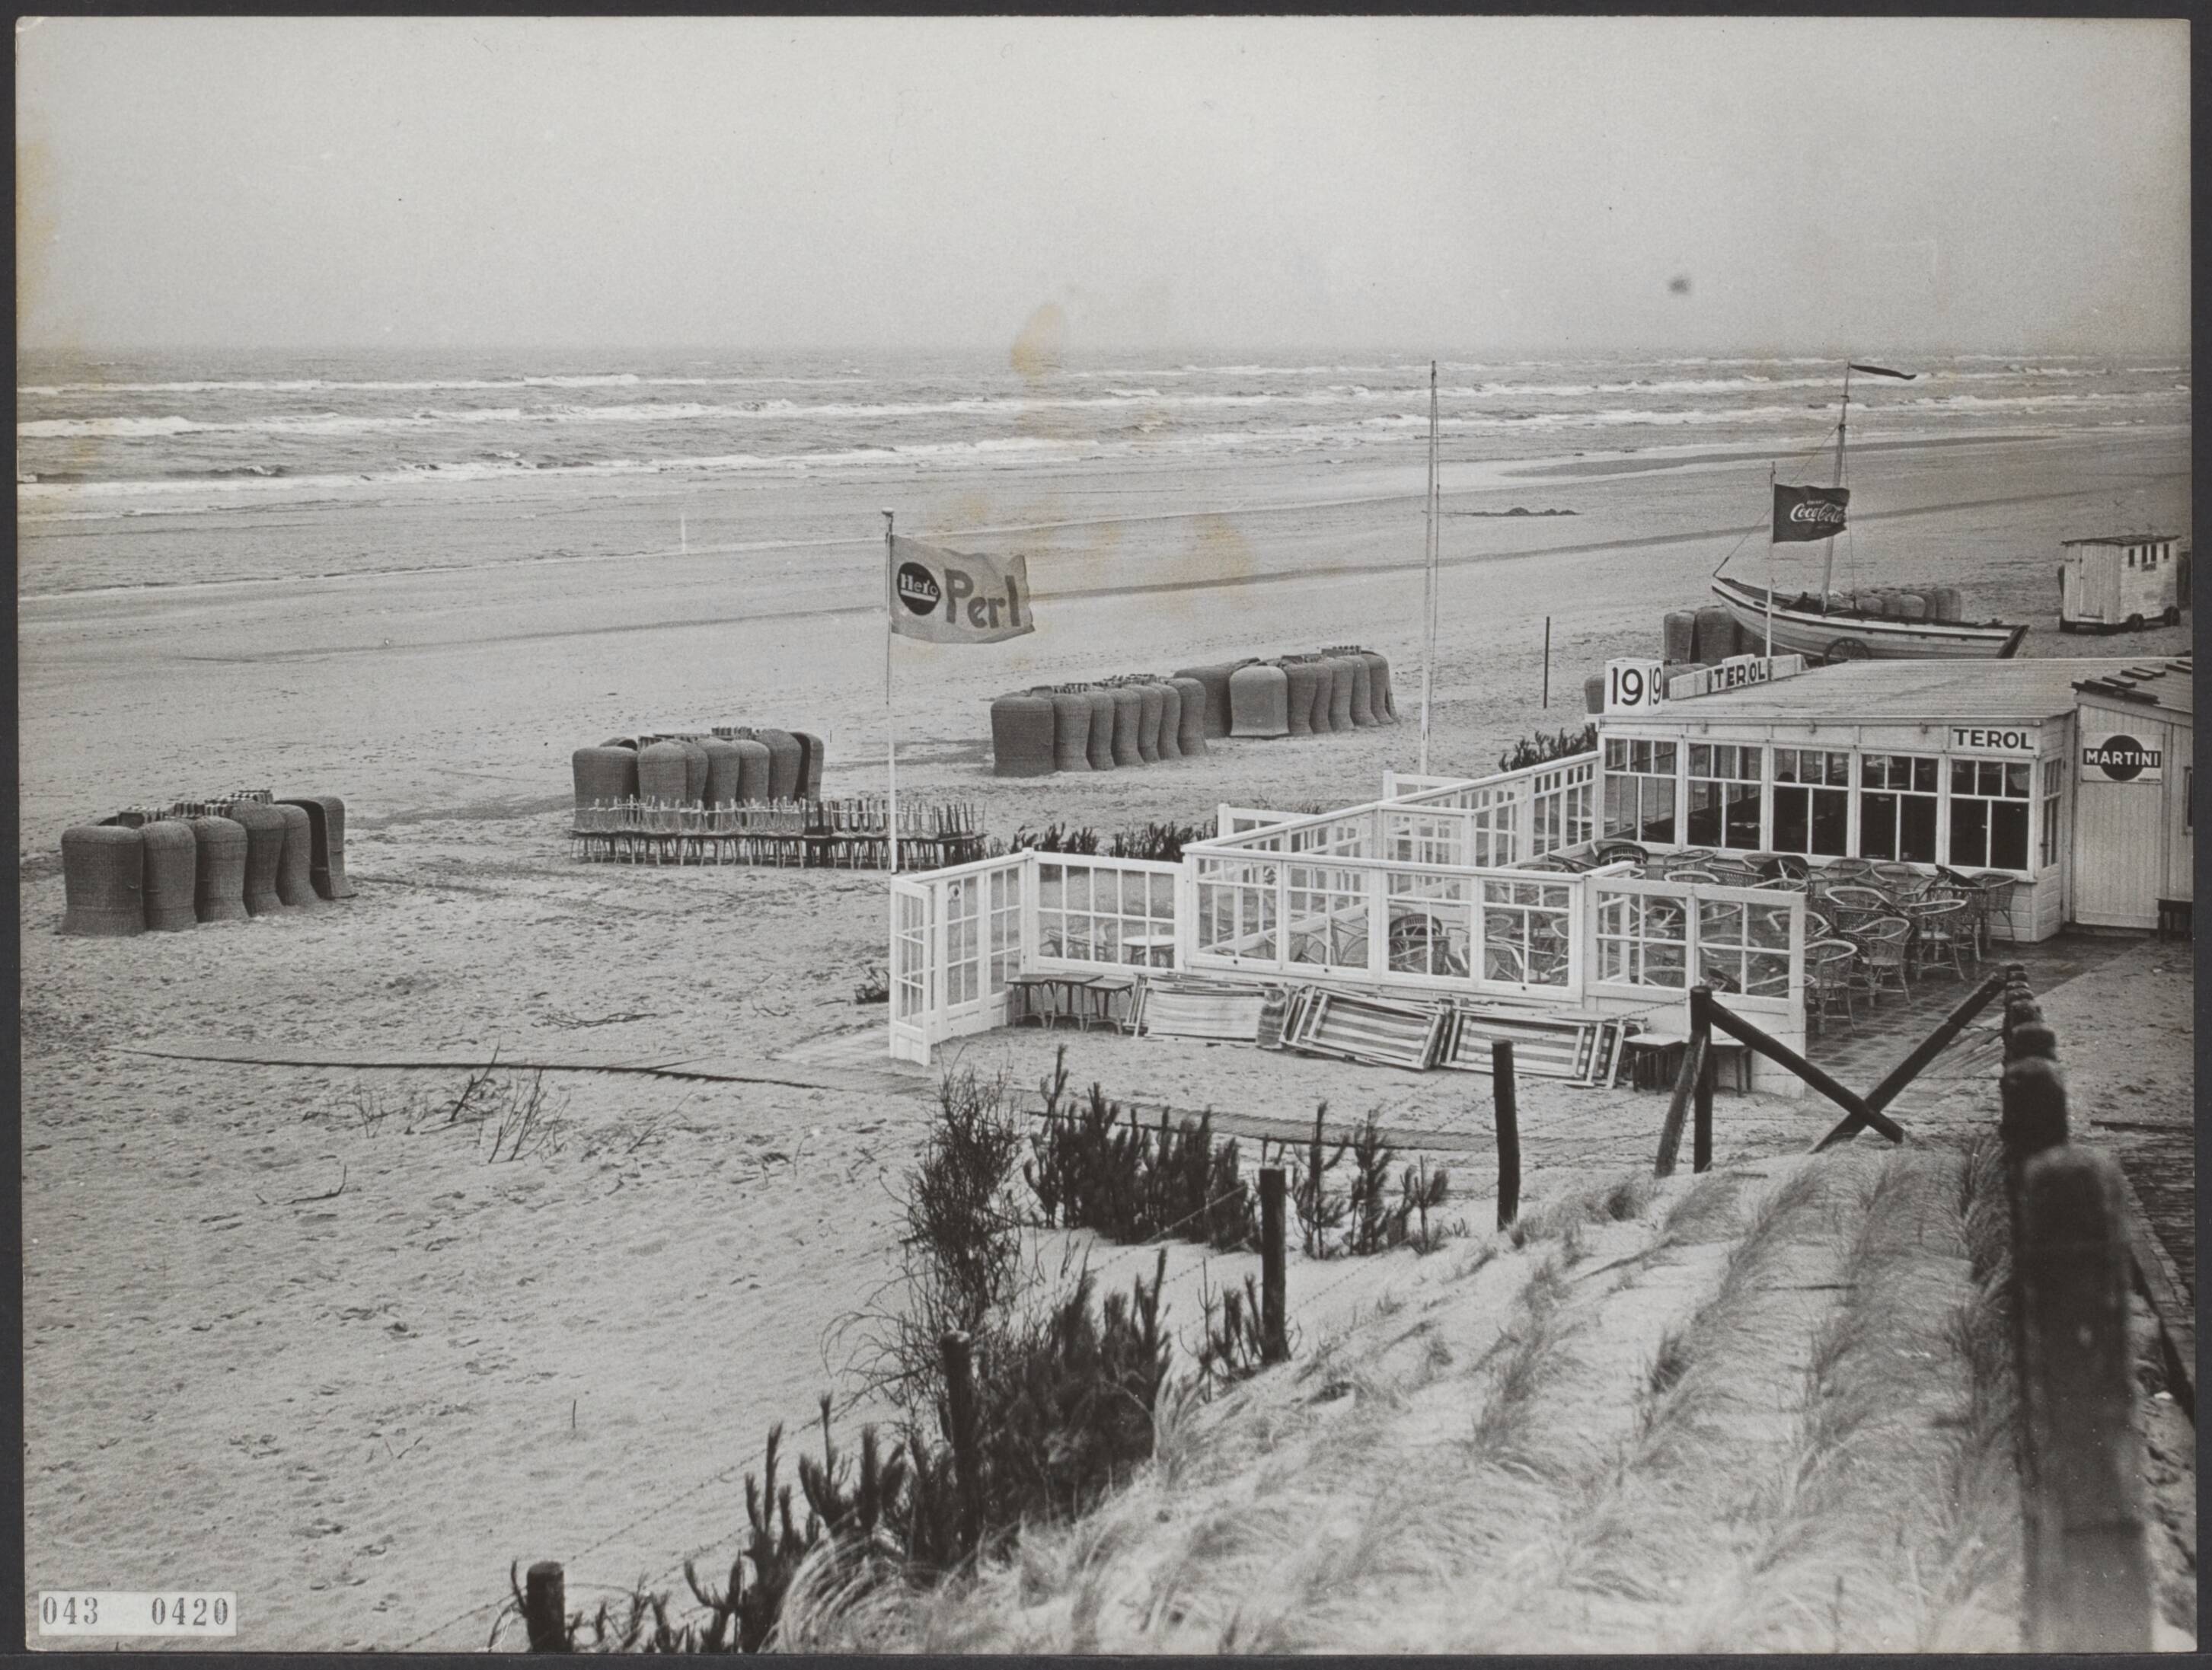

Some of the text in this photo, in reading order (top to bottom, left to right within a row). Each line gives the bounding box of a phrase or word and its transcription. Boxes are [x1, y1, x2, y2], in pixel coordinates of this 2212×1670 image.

[901, 573, 939, 596] Hero
[945, 569, 1021, 629] Perl
[1612, 667, 1643, 705] 19
[1649, 667, 1661, 705] 19
[1714, 661, 1766, 688] TEROL
[1953, 729, 2034, 749] TEROL
[2086, 750, 2158, 766] MARTINI
